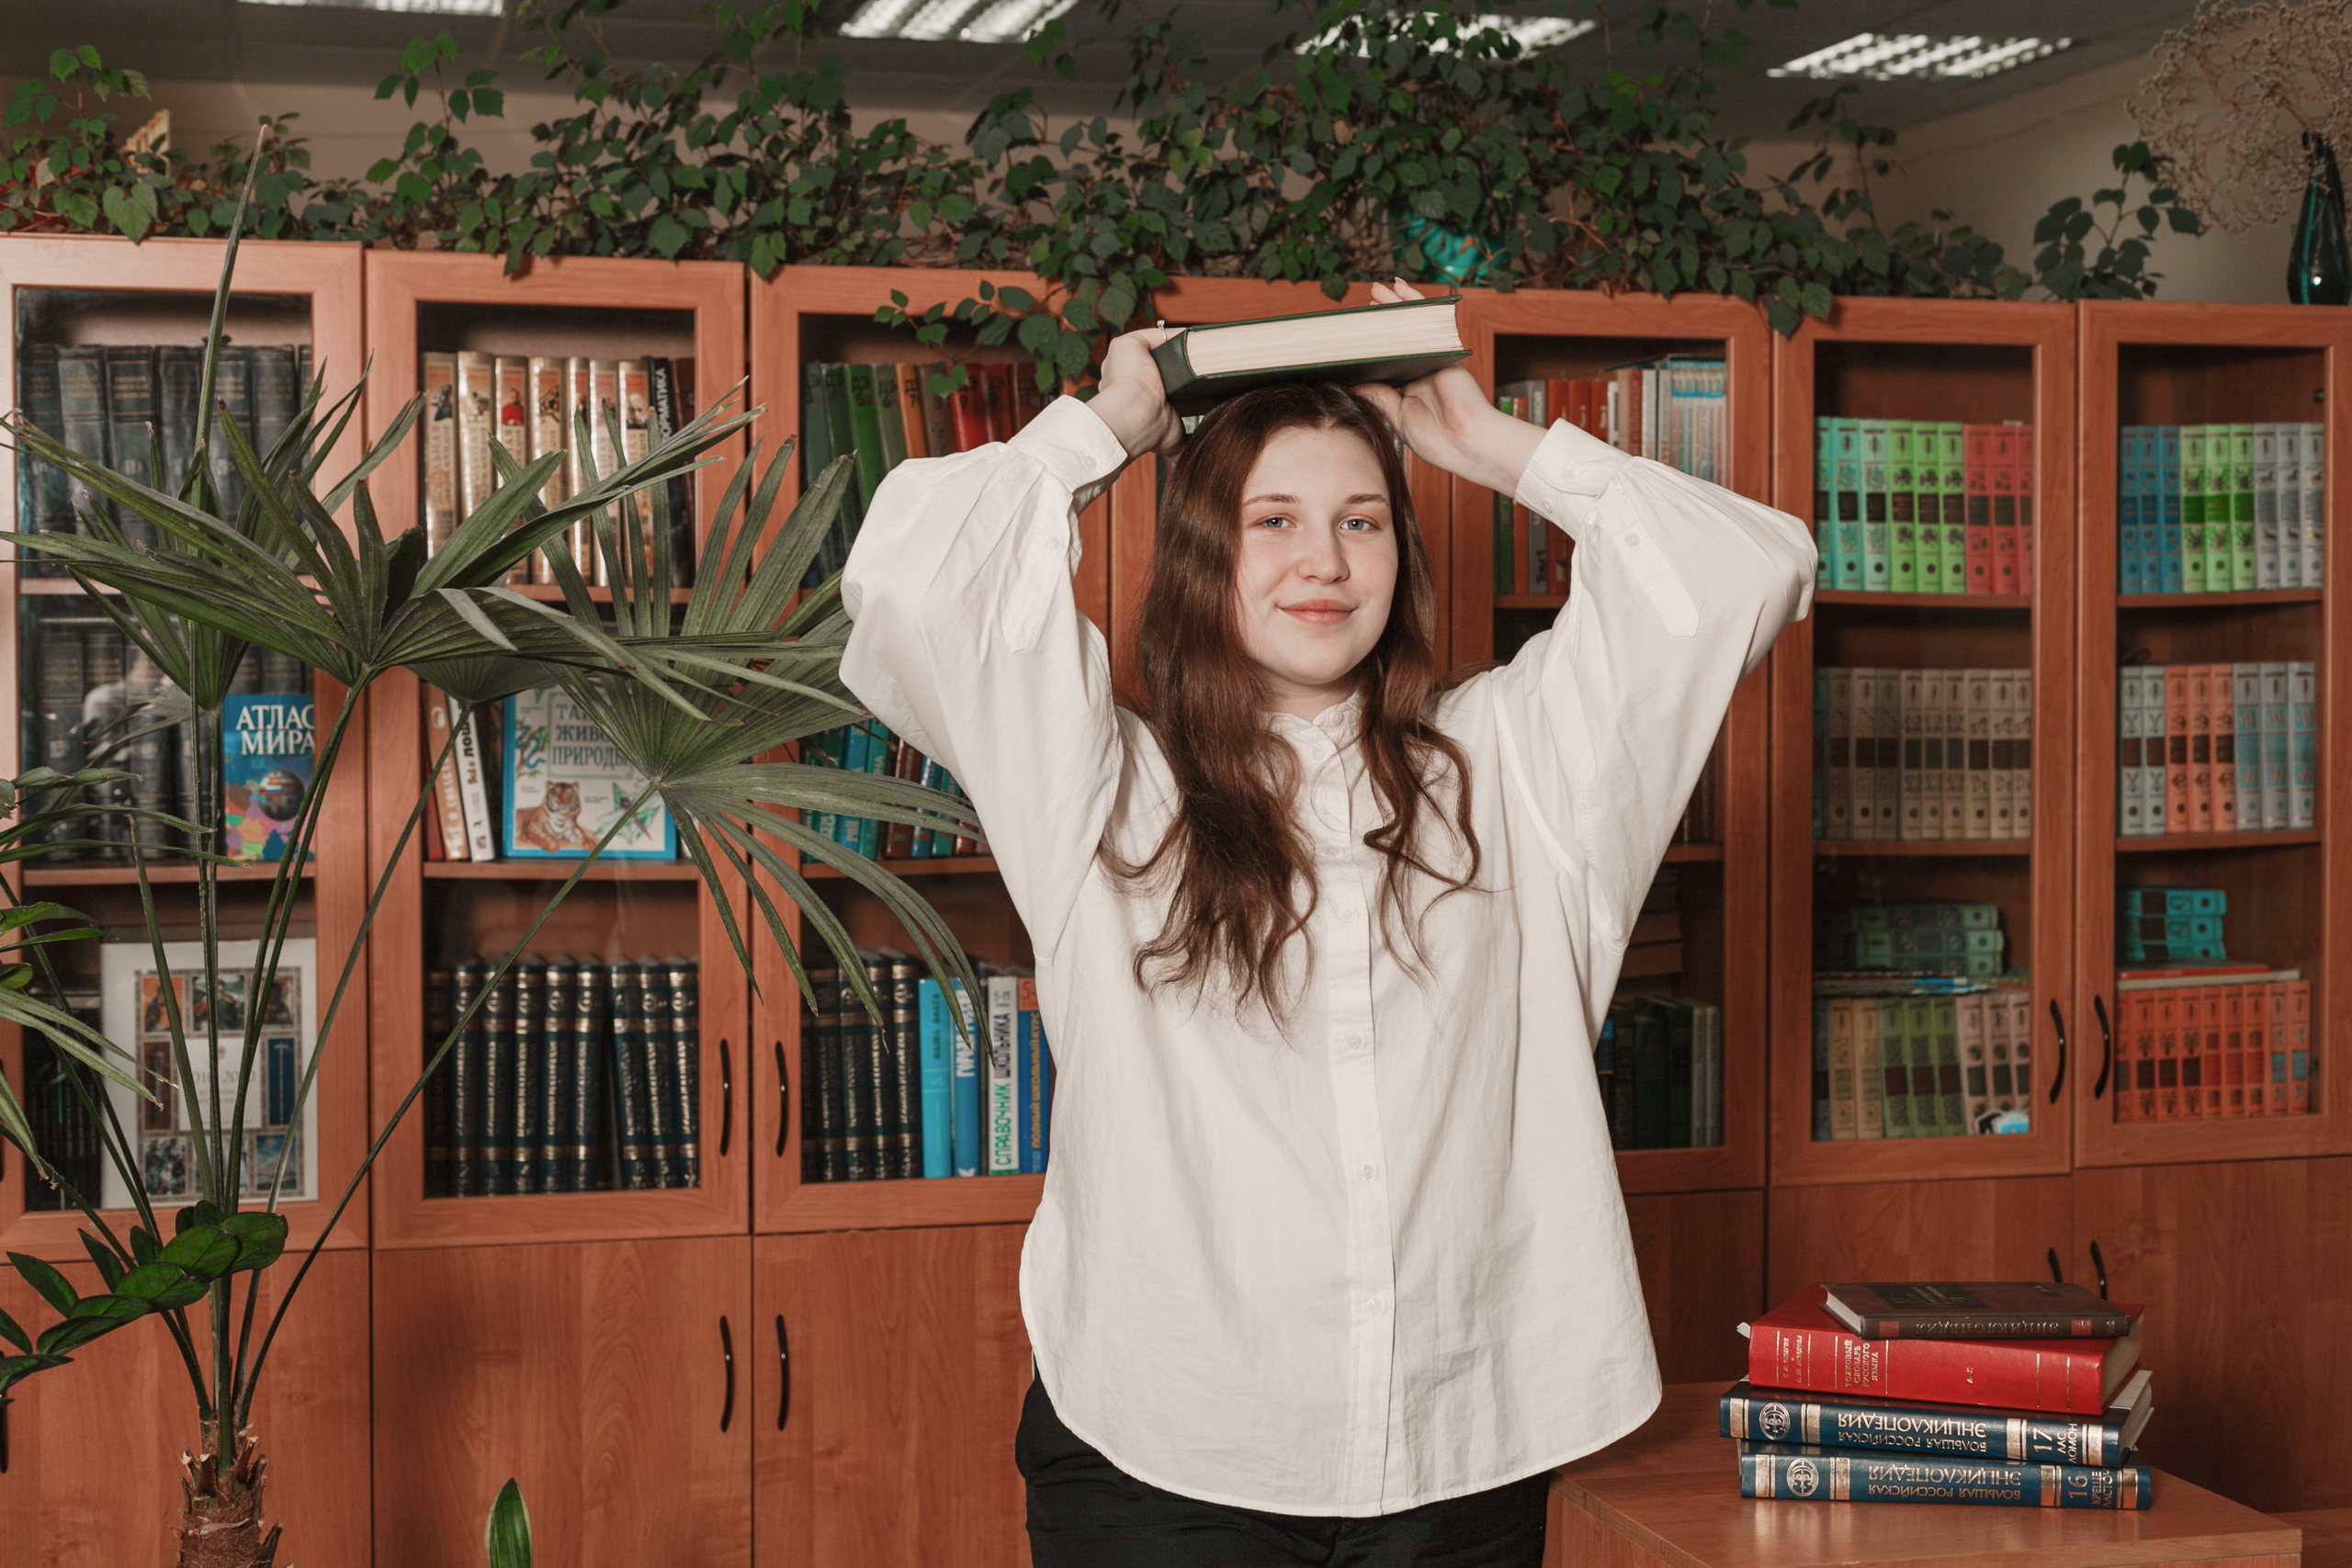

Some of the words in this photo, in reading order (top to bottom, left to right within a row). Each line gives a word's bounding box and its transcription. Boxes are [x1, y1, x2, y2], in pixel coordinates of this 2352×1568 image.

[655, 367, 673, 444] ОРМАТИКА
[236, 705, 314, 731] АТЛАС
[241, 730, 315, 755] МИРА
[552, 746, 628, 771] ПРИРОДЫ
[1029, 1012, 1040, 1038] КУРС
[993, 1013, 1011, 1079] ШКОЛЬНИКА
[1029, 1039, 1041, 1101] ШКОЛЬНЫЙ
[994, 1083, 1012, 1166] СПРАВОЧНИК
[1030, 1102, 1042, 1149] ПОЛНЫЙ
[1914, 1319, 2059, 1335] ЭНЦИКЛОПЕДИЯ
[1843, 1338, 1853, 1387] ТОЛКОВЫЙ
[1853, 1345, 1861, 1383] СЛОВАРЬ
[1862, 1342, 1871, 1388] РУССКОГО
[1871, 1351, 1879, 1382] ЯЗЫКА
[1838, 1412, 1986, 1438] ЭНЦИКЛОПЕДИЯ
[1838, 1431, 1921, 1449] РОССИЙСКАЯ
[1925, 1437, 1986, 1453] БОЛЬШАЯ
[2032, 1427, 2053, 1452] 17
[2057, 1431, 2066, 1454] ЛАС
[2067, 1423, 2078, 1464] ЛОМОН
[1868, 1463, 2021, 1486] ЭНЦИКЛОПЕДИЯ
[2067, 1473, 2088, 1499] 16
[1868, 1483, 1953, 1498] РОССИЙСКАЯ
[1959, 1486, 2021, 1500] БОЛЬШАЯ
[2091, 1471, 2102, 1505] КРЕЩЕ
